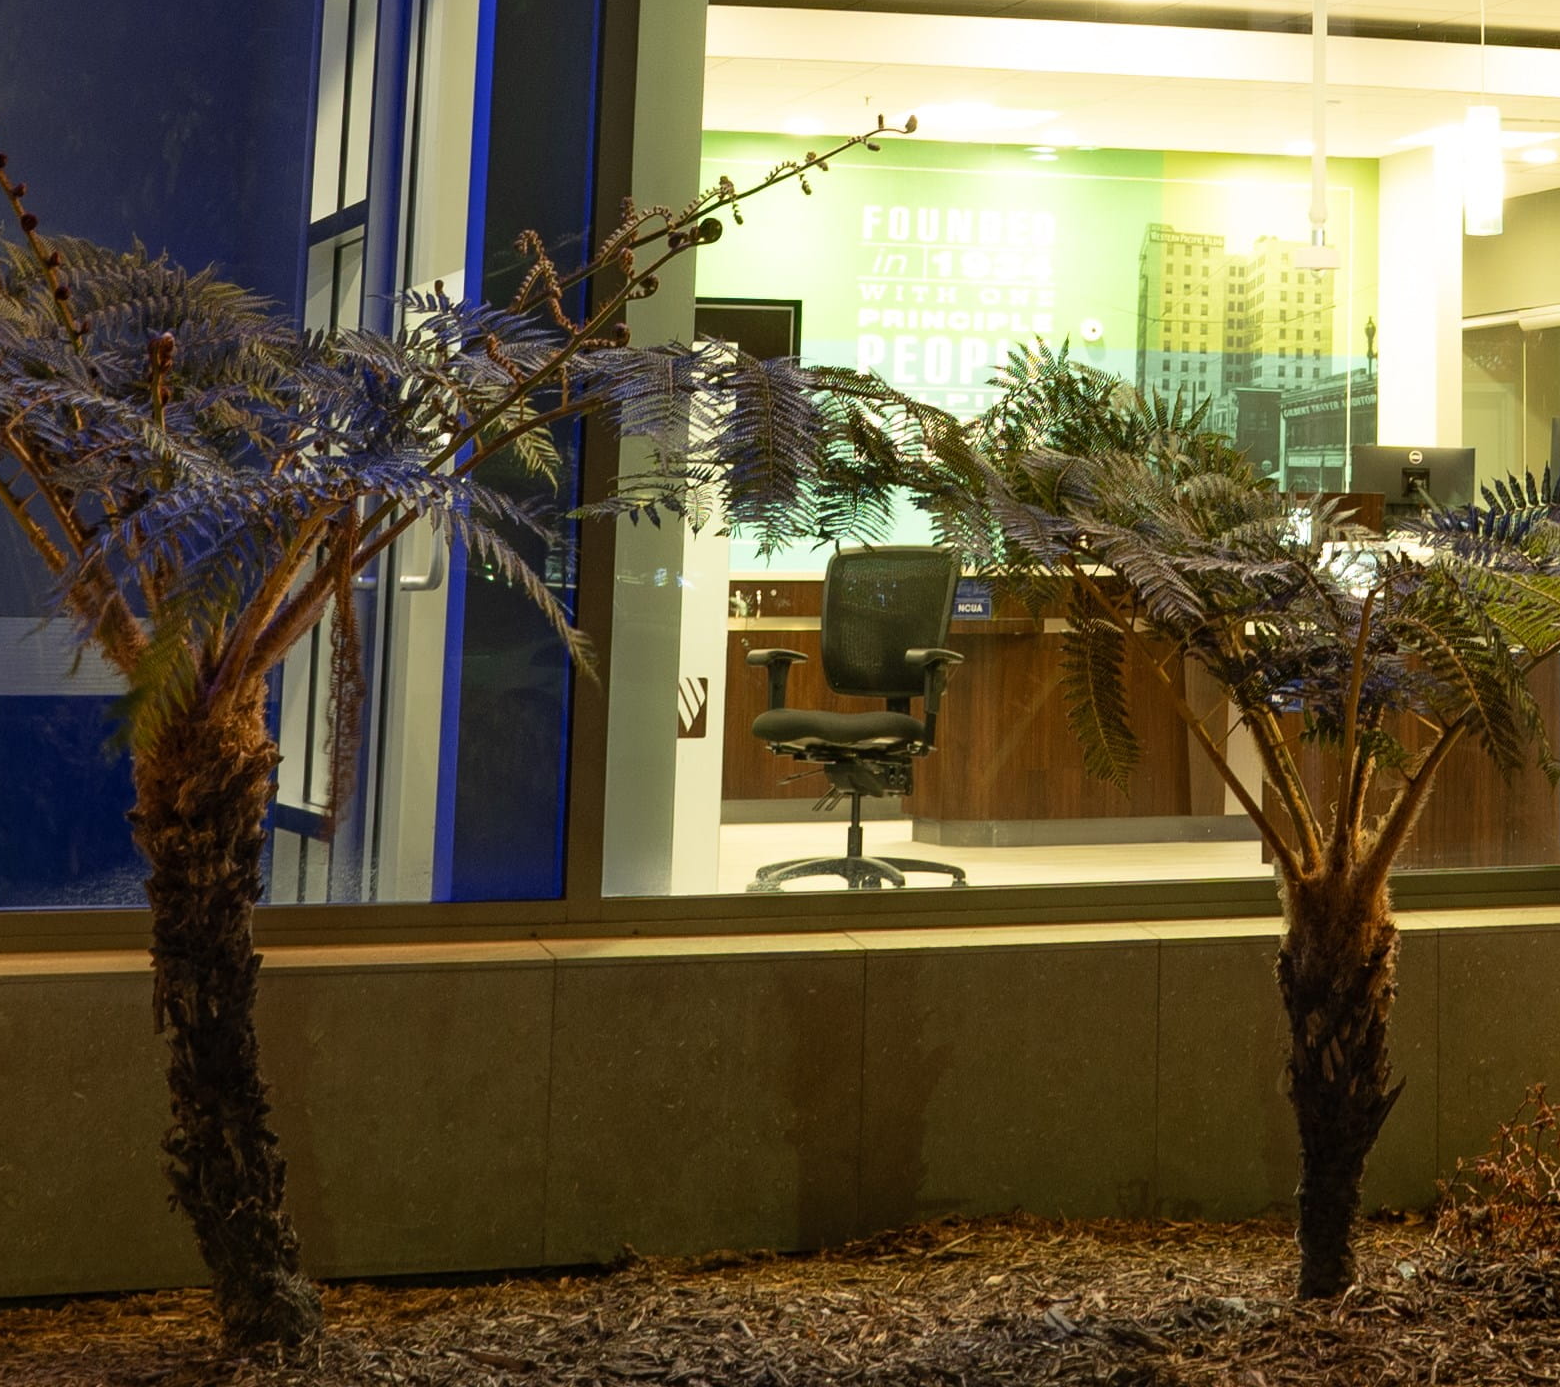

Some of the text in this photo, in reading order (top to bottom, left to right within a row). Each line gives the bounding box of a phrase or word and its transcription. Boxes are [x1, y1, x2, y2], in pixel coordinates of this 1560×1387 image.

[863, 205, 1056, 245] FOUNDED
[872, 248, 907, 273] in
[859, 283, 1055, 305] WITH ONE
[858, 309, 1053, 332] PRINCIPLE
[957, 602, 984, 613] NCUA
